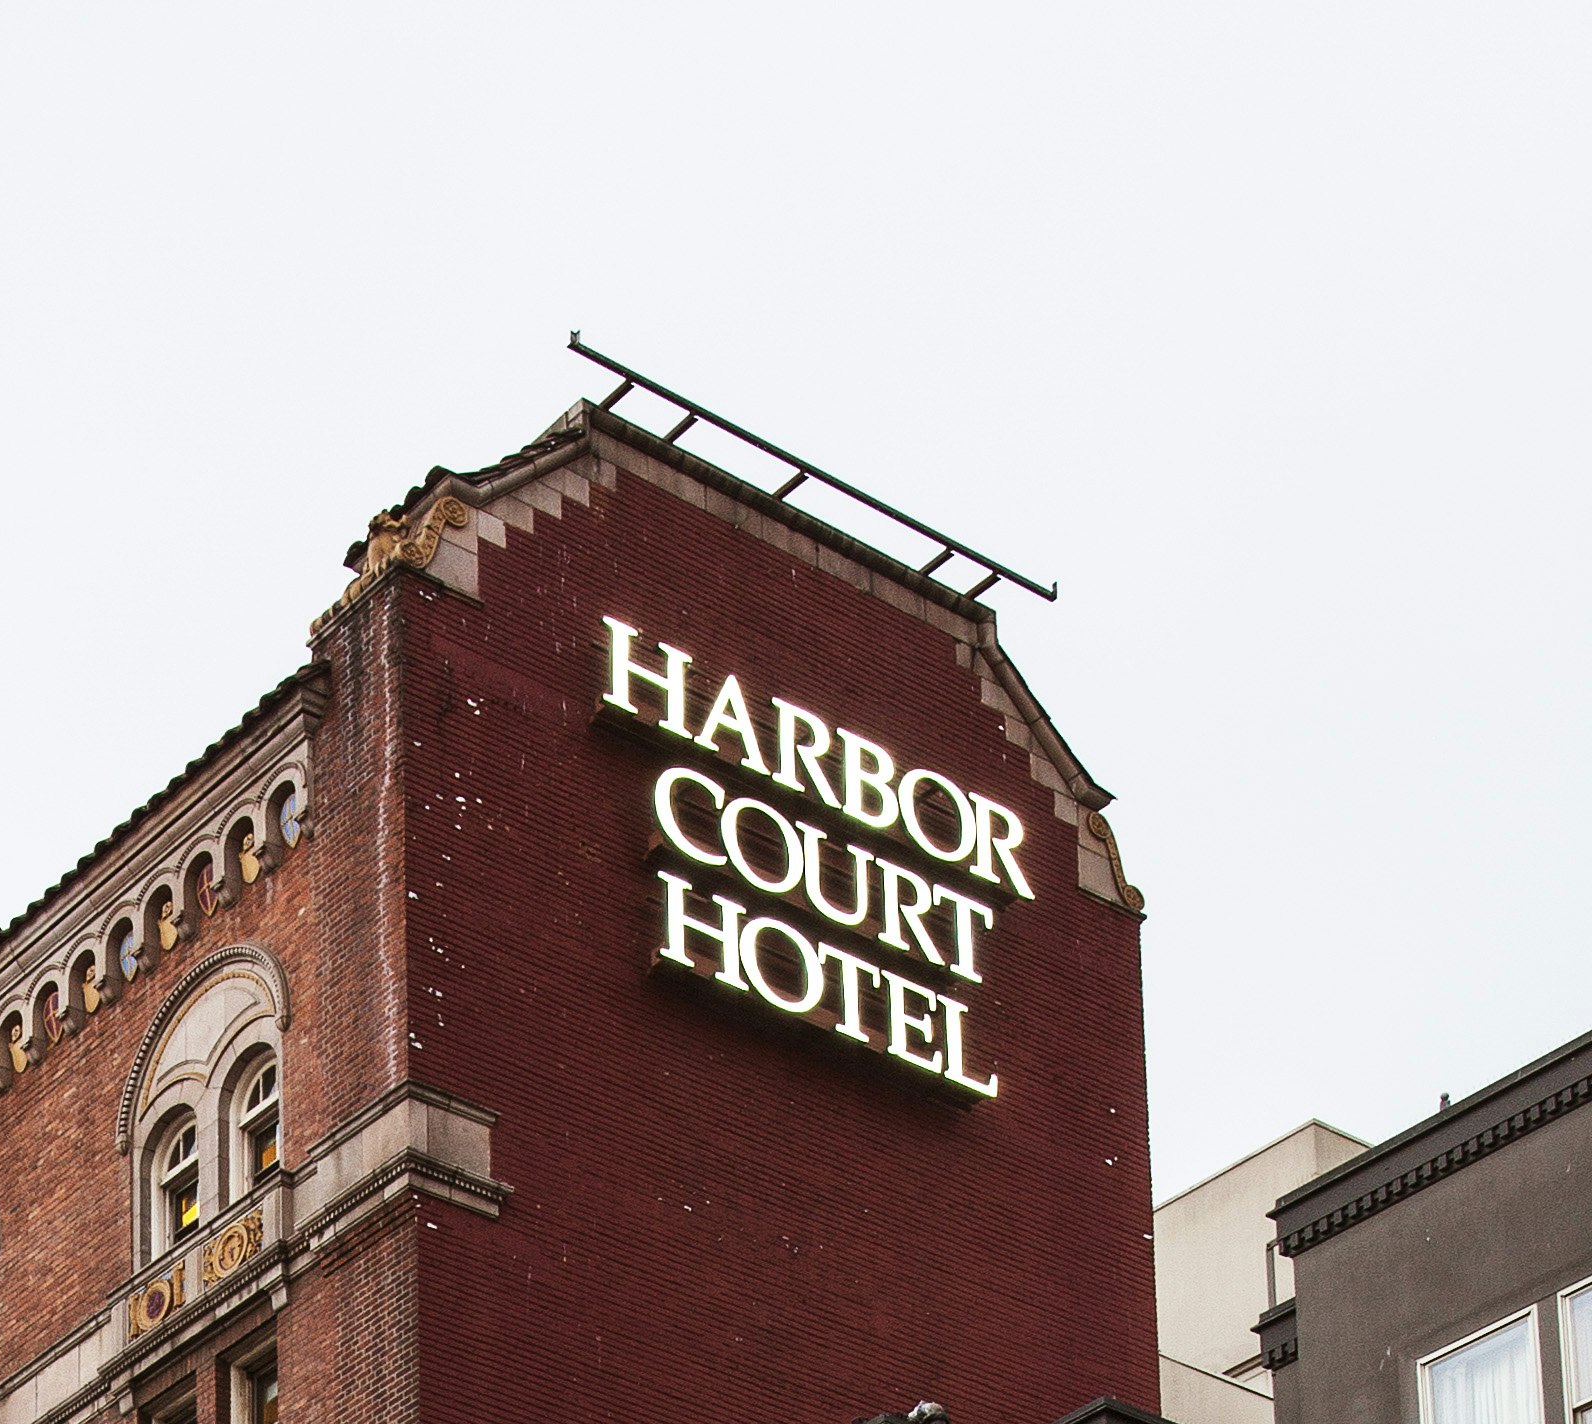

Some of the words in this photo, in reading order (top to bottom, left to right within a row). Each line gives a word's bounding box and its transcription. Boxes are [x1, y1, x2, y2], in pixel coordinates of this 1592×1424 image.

[602, 615, 1036, 901] HARBOR
[654, 766, 994, 983] COURT
[657, 870, 999, 1098] HOTEL
